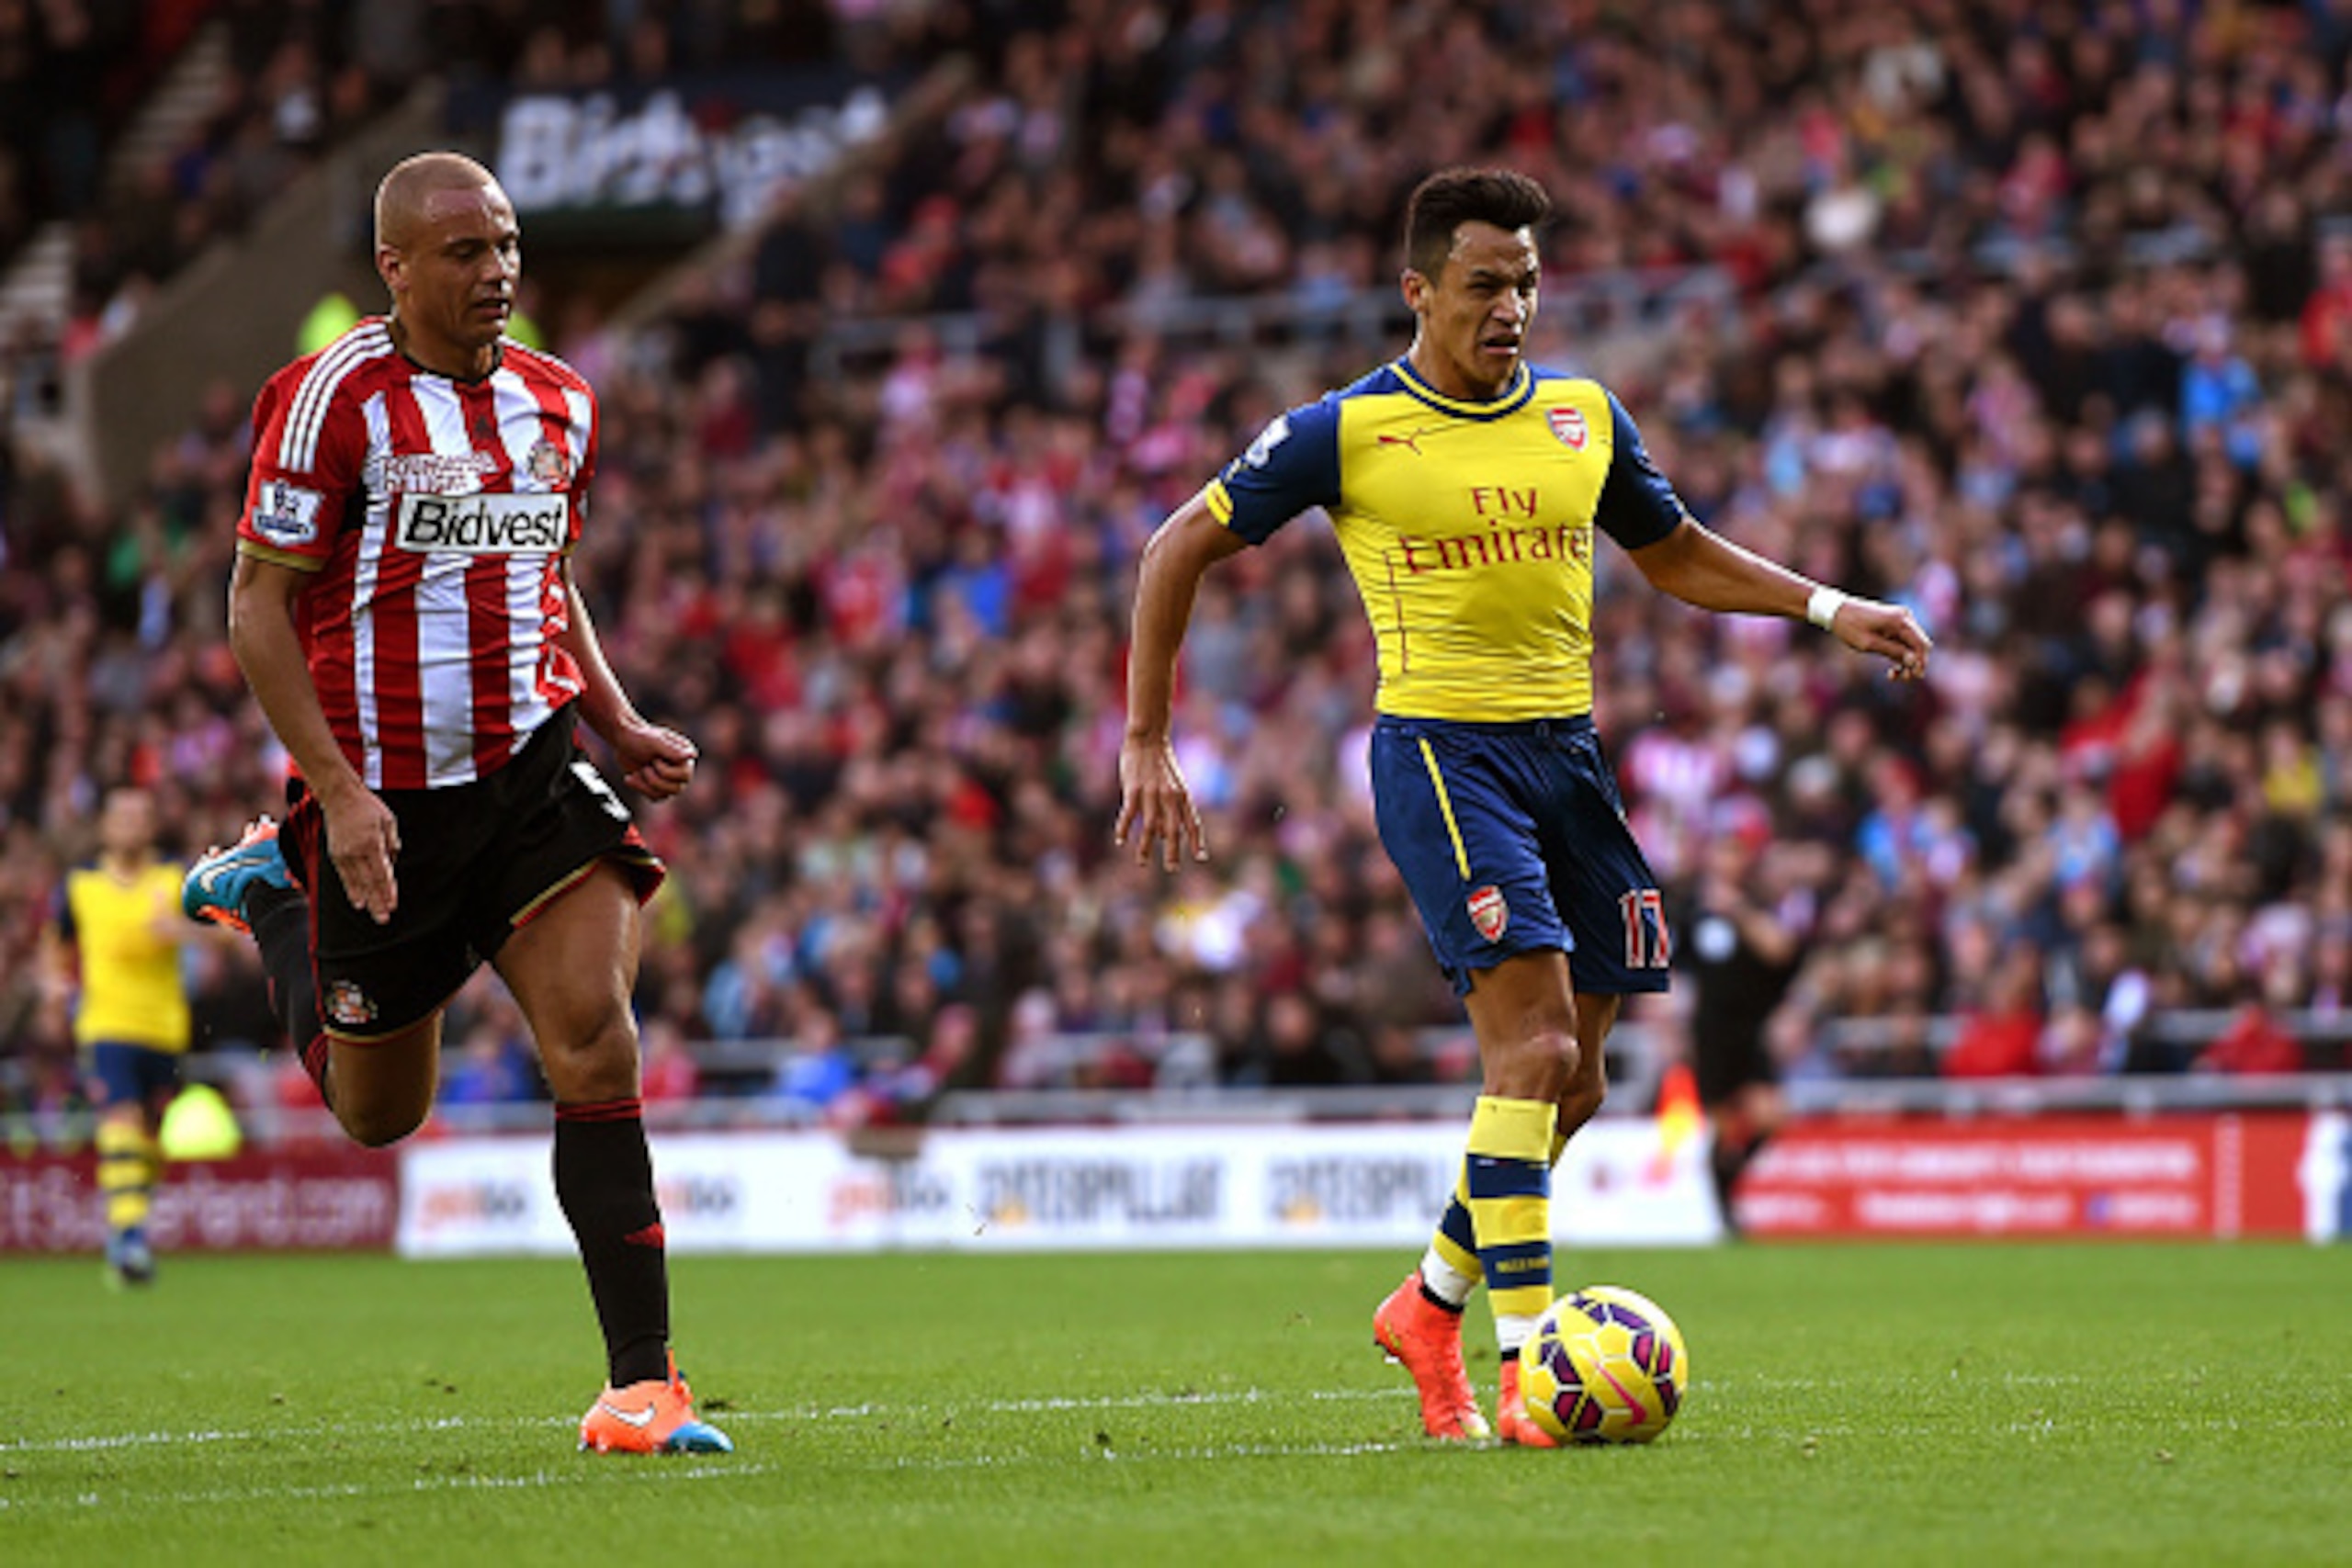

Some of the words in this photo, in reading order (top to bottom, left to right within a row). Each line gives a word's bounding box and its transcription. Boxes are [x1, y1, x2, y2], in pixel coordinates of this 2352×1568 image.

[404, 499, 563, 547] Bidvest
[1470, 486, 1536, 518] Fly
[1617, 887, 1672, 969] 17
